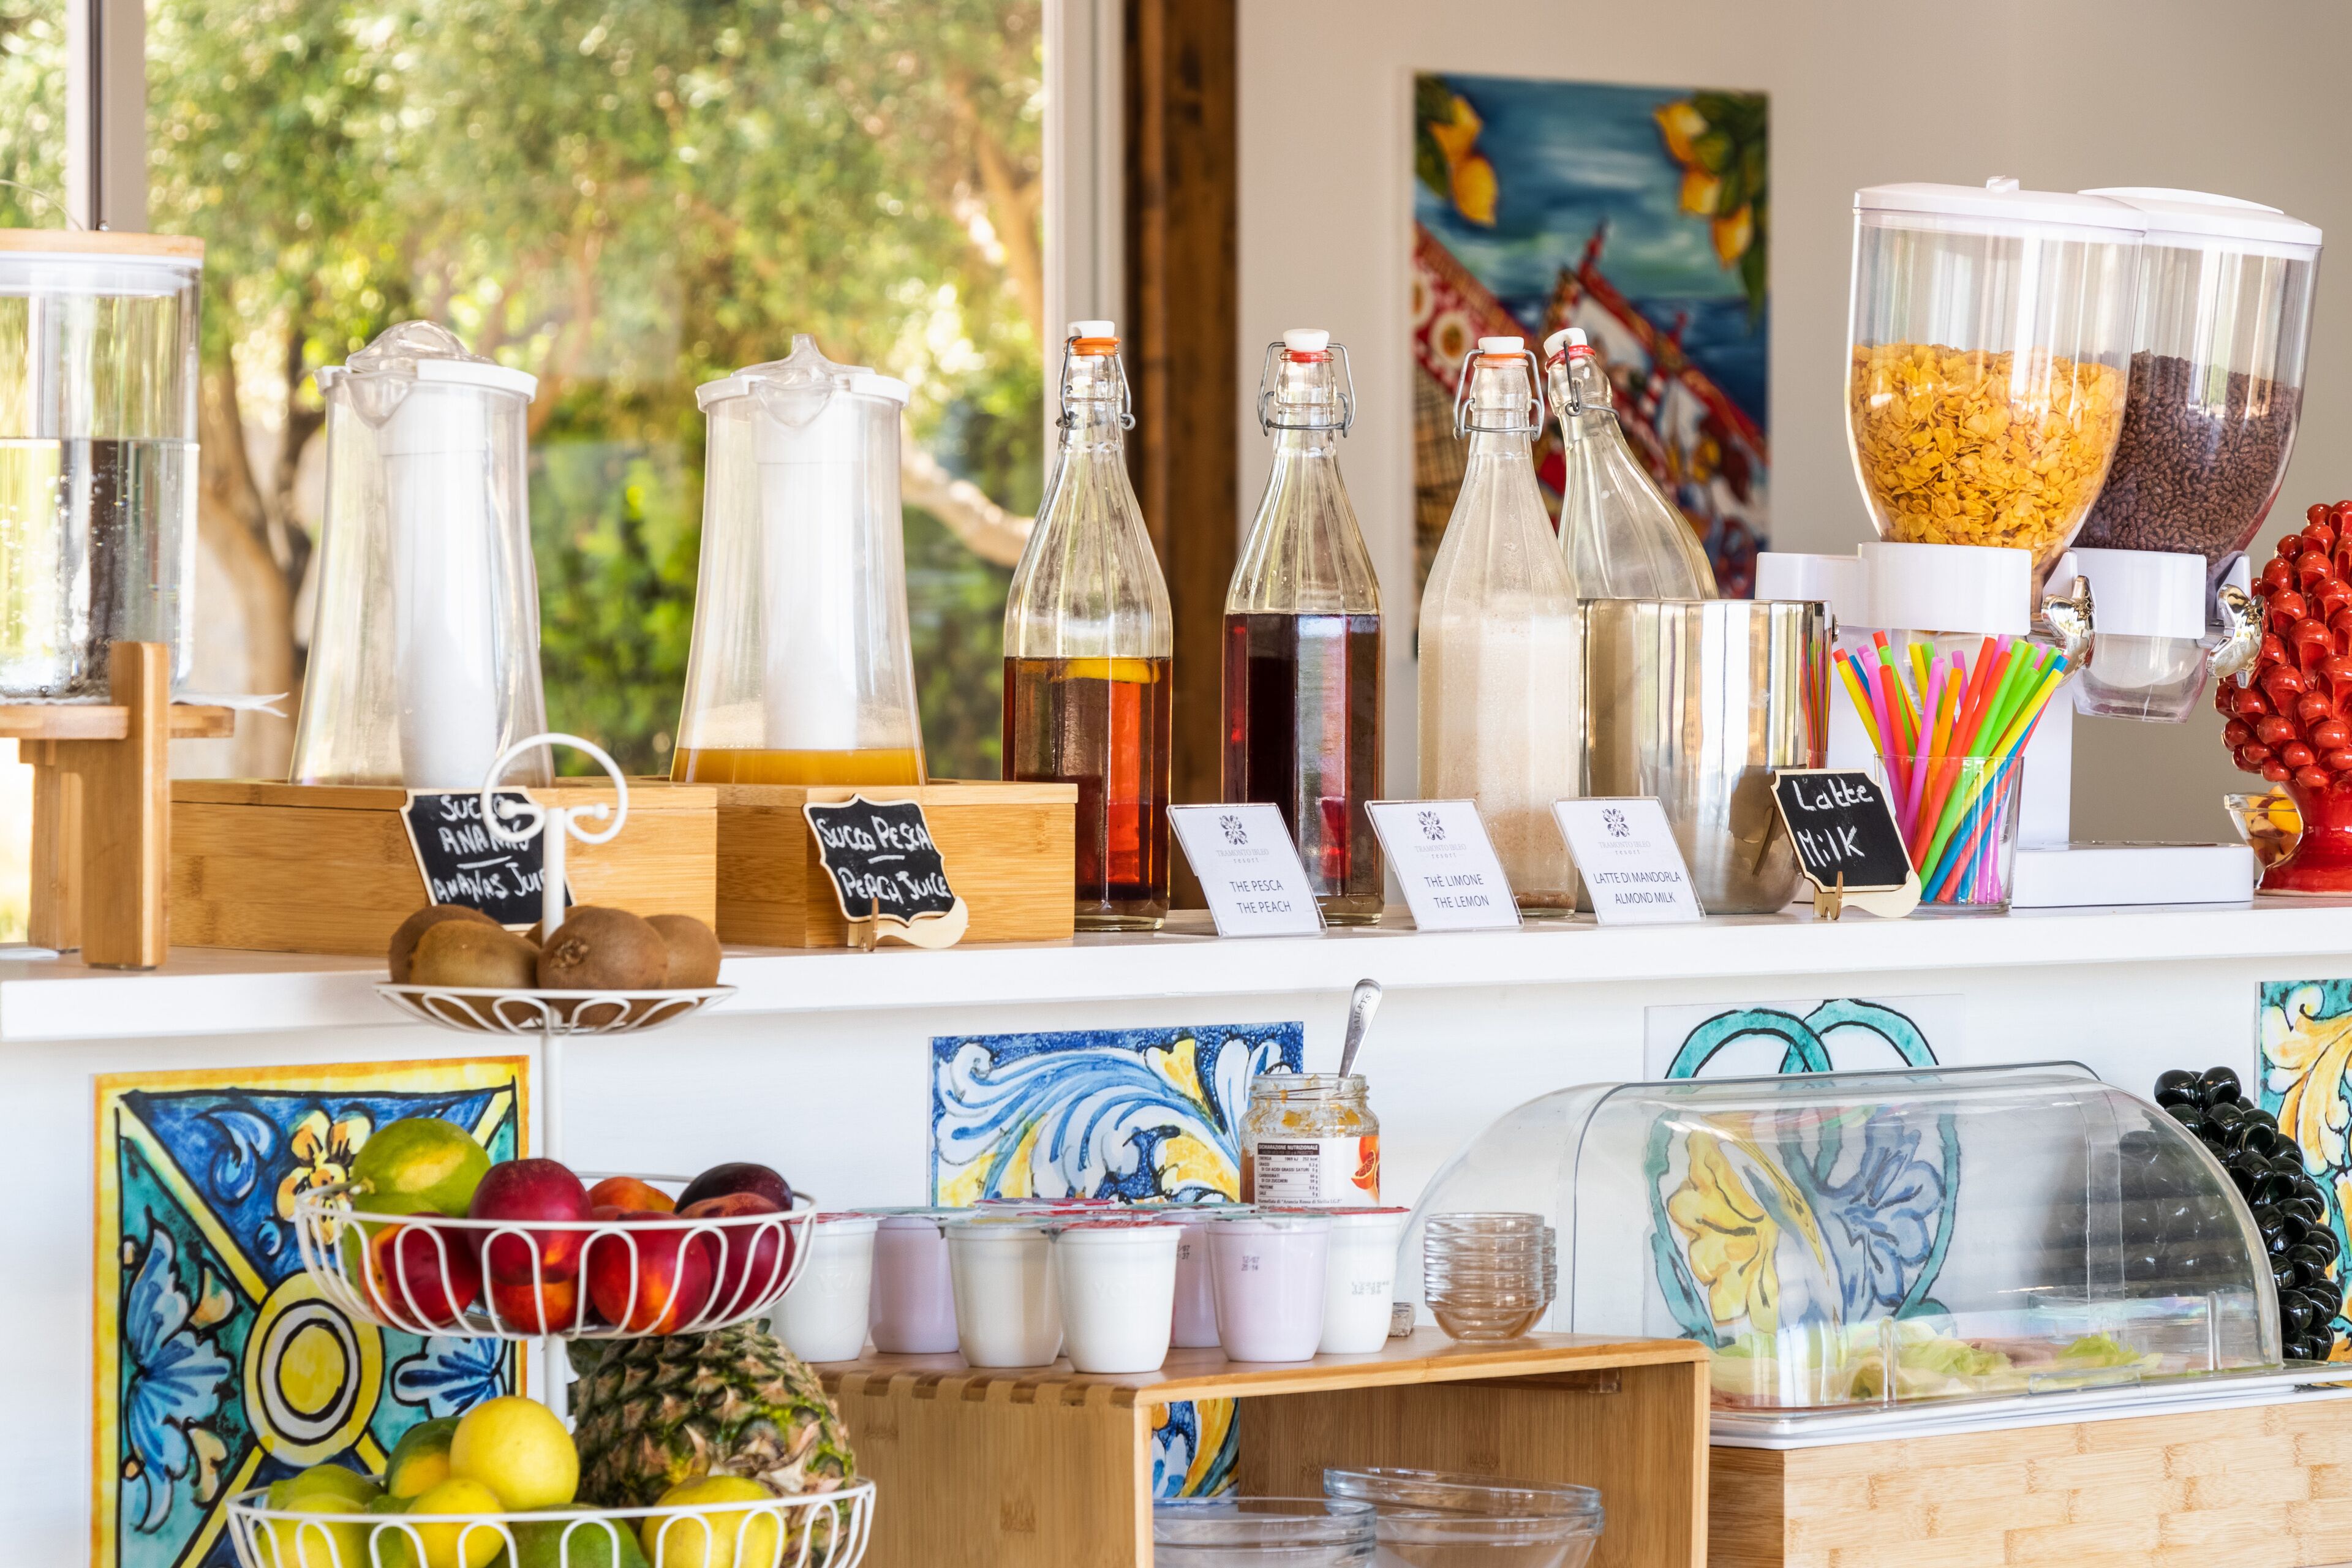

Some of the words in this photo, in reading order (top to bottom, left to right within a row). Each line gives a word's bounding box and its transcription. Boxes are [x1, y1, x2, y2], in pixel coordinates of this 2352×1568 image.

[1792, 778, 1874, 811] Latte
[1423, 874, 1445, 888] THÈ
[1445, 874, 1484, 886] LIMONE
[1593, 872, 1621, 883] LATTE
[1621, 872, 1631, 883] DI
[1632, 872, 1681, 882] MANDORLA
[1229, 881, 1250, 892] THE
[1251, 880, 1284, 891] PESCA
[1433, 897, 1453, 908] THE
[1454, 895, 1490, 908] LEMON
[1615, 892, 1653, 903] ALMOND
[1654, 892, 1676, 903] MILK
[1236, 902, 1257, 913] THE
[1258, 900, 1292, 913] PEACH
[1353, 993, 1372, 1032] BAILEYS
